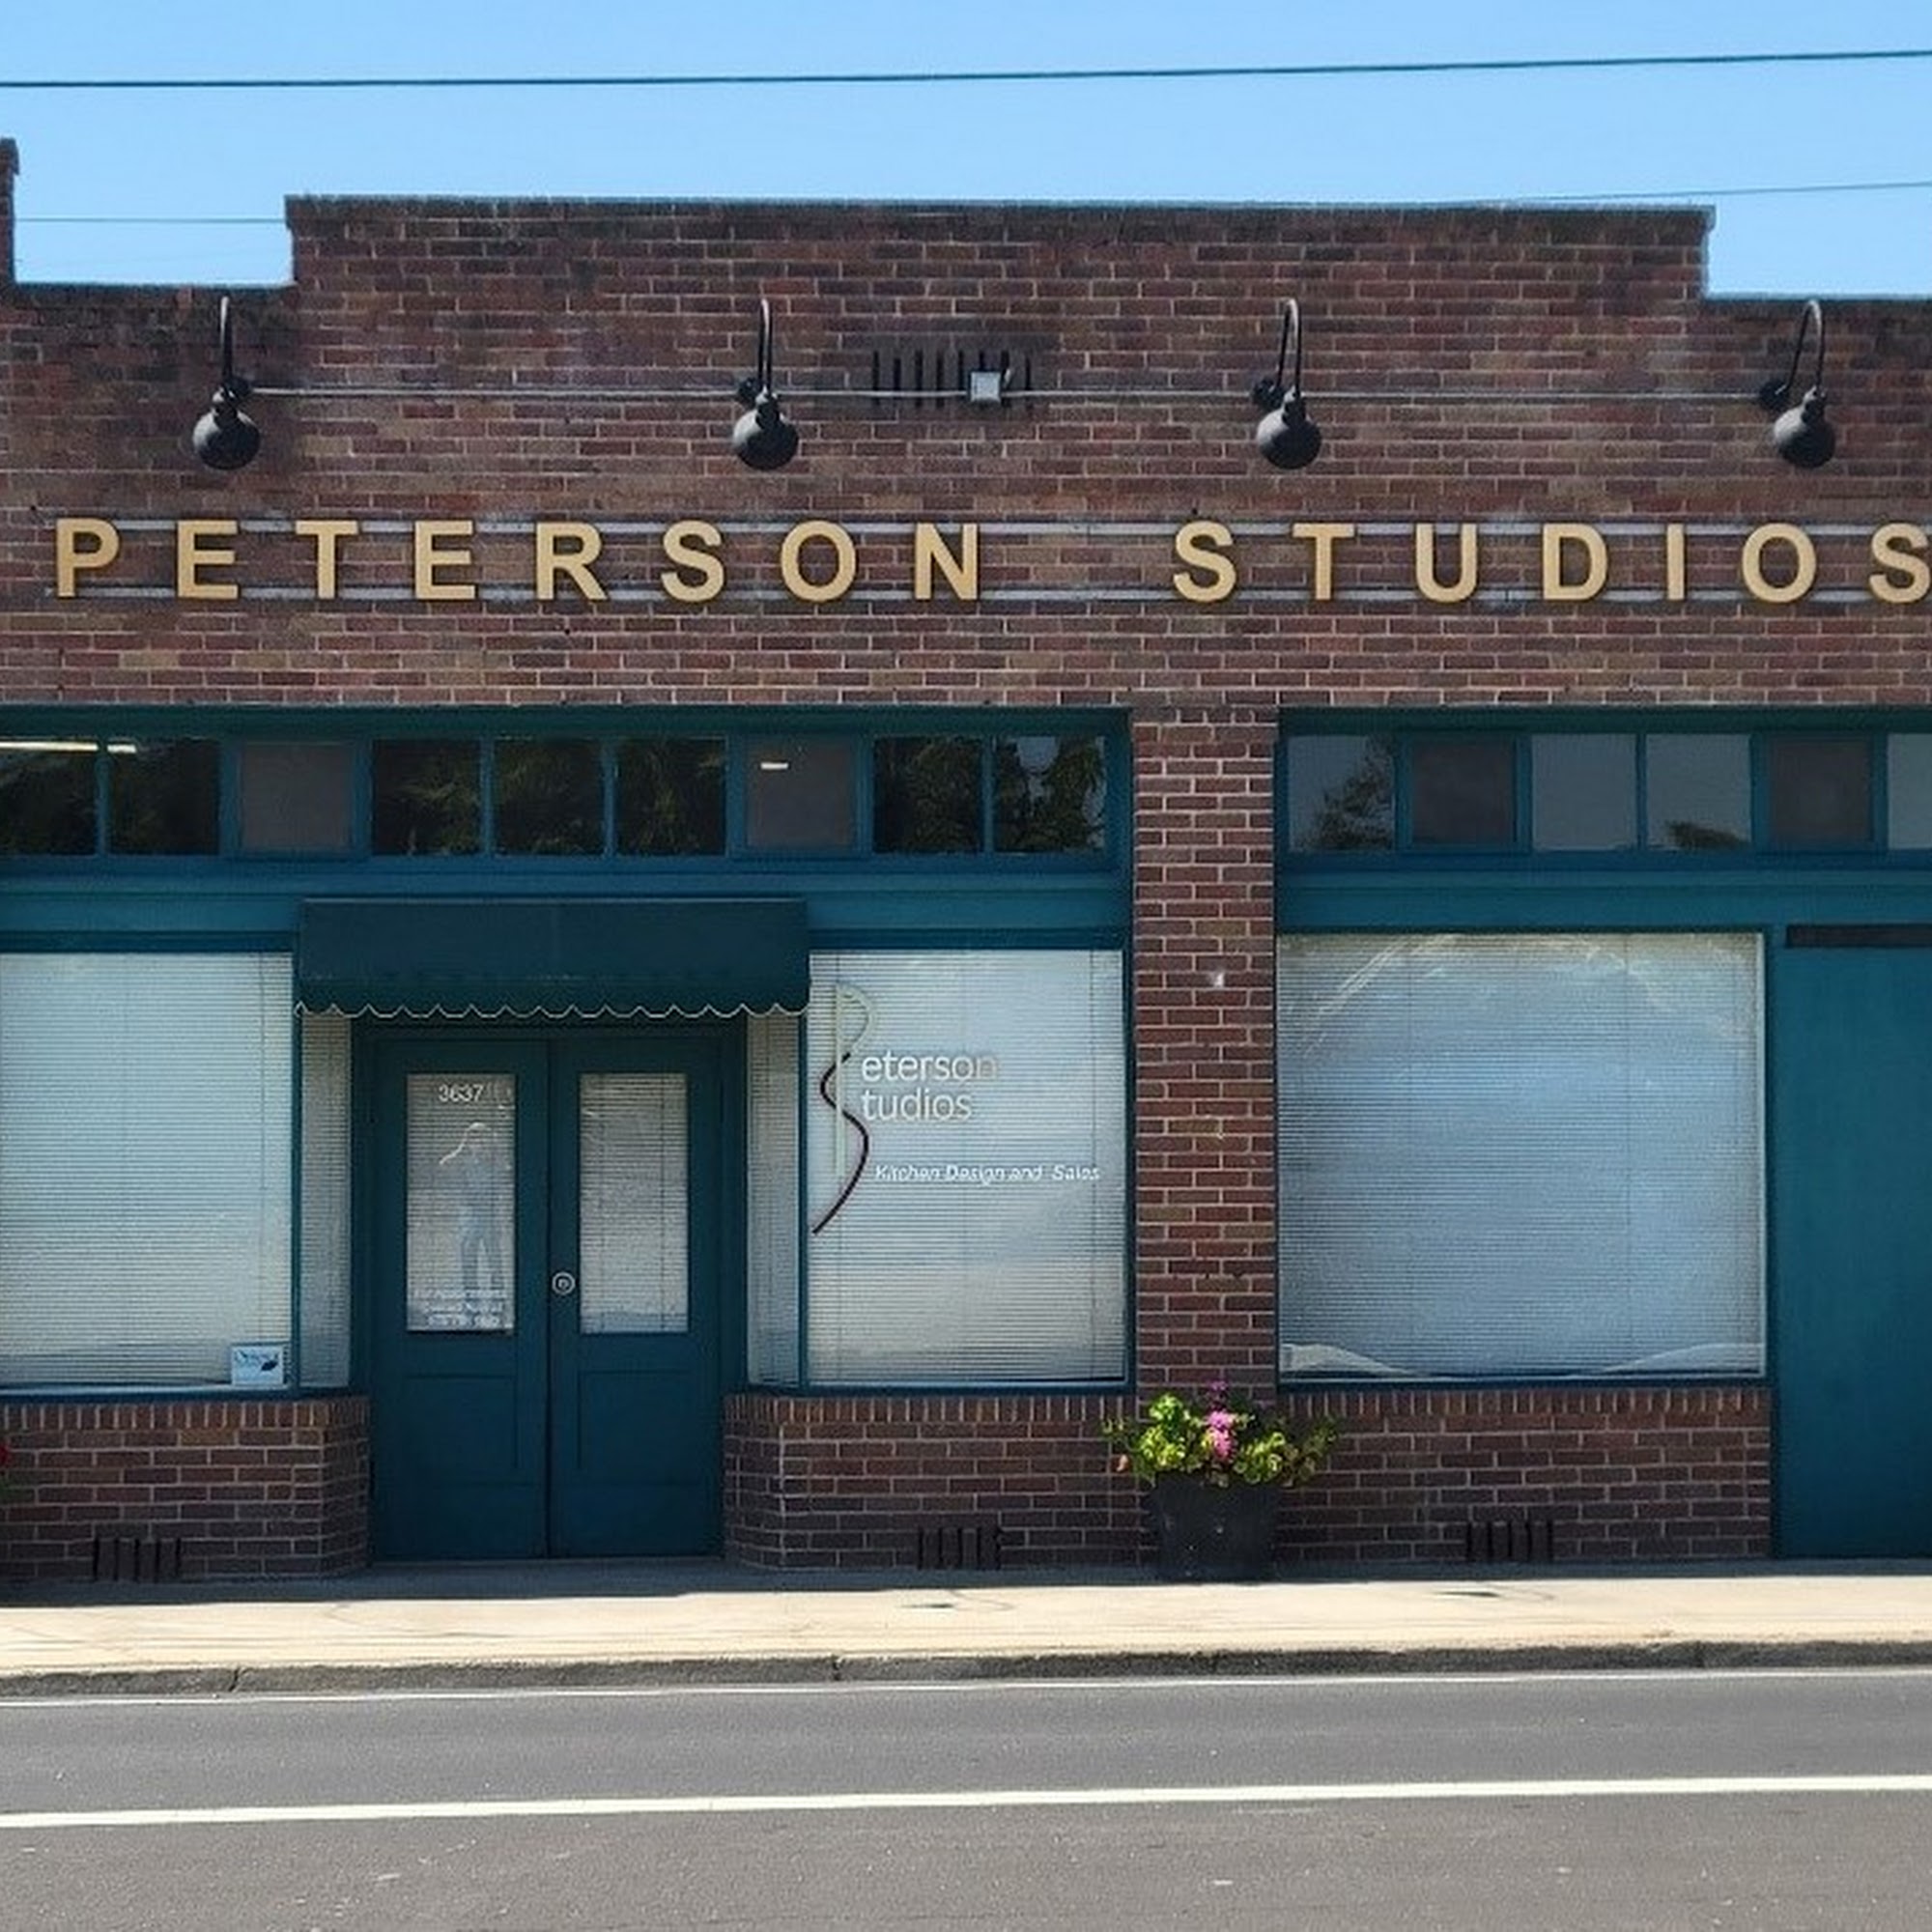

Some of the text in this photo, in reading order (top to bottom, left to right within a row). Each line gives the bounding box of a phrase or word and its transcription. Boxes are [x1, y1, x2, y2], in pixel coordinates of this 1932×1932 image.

[56, 518, 1930, 605] PETERSON STUDIOS
[439, 1083, 484, 1102] 3637
